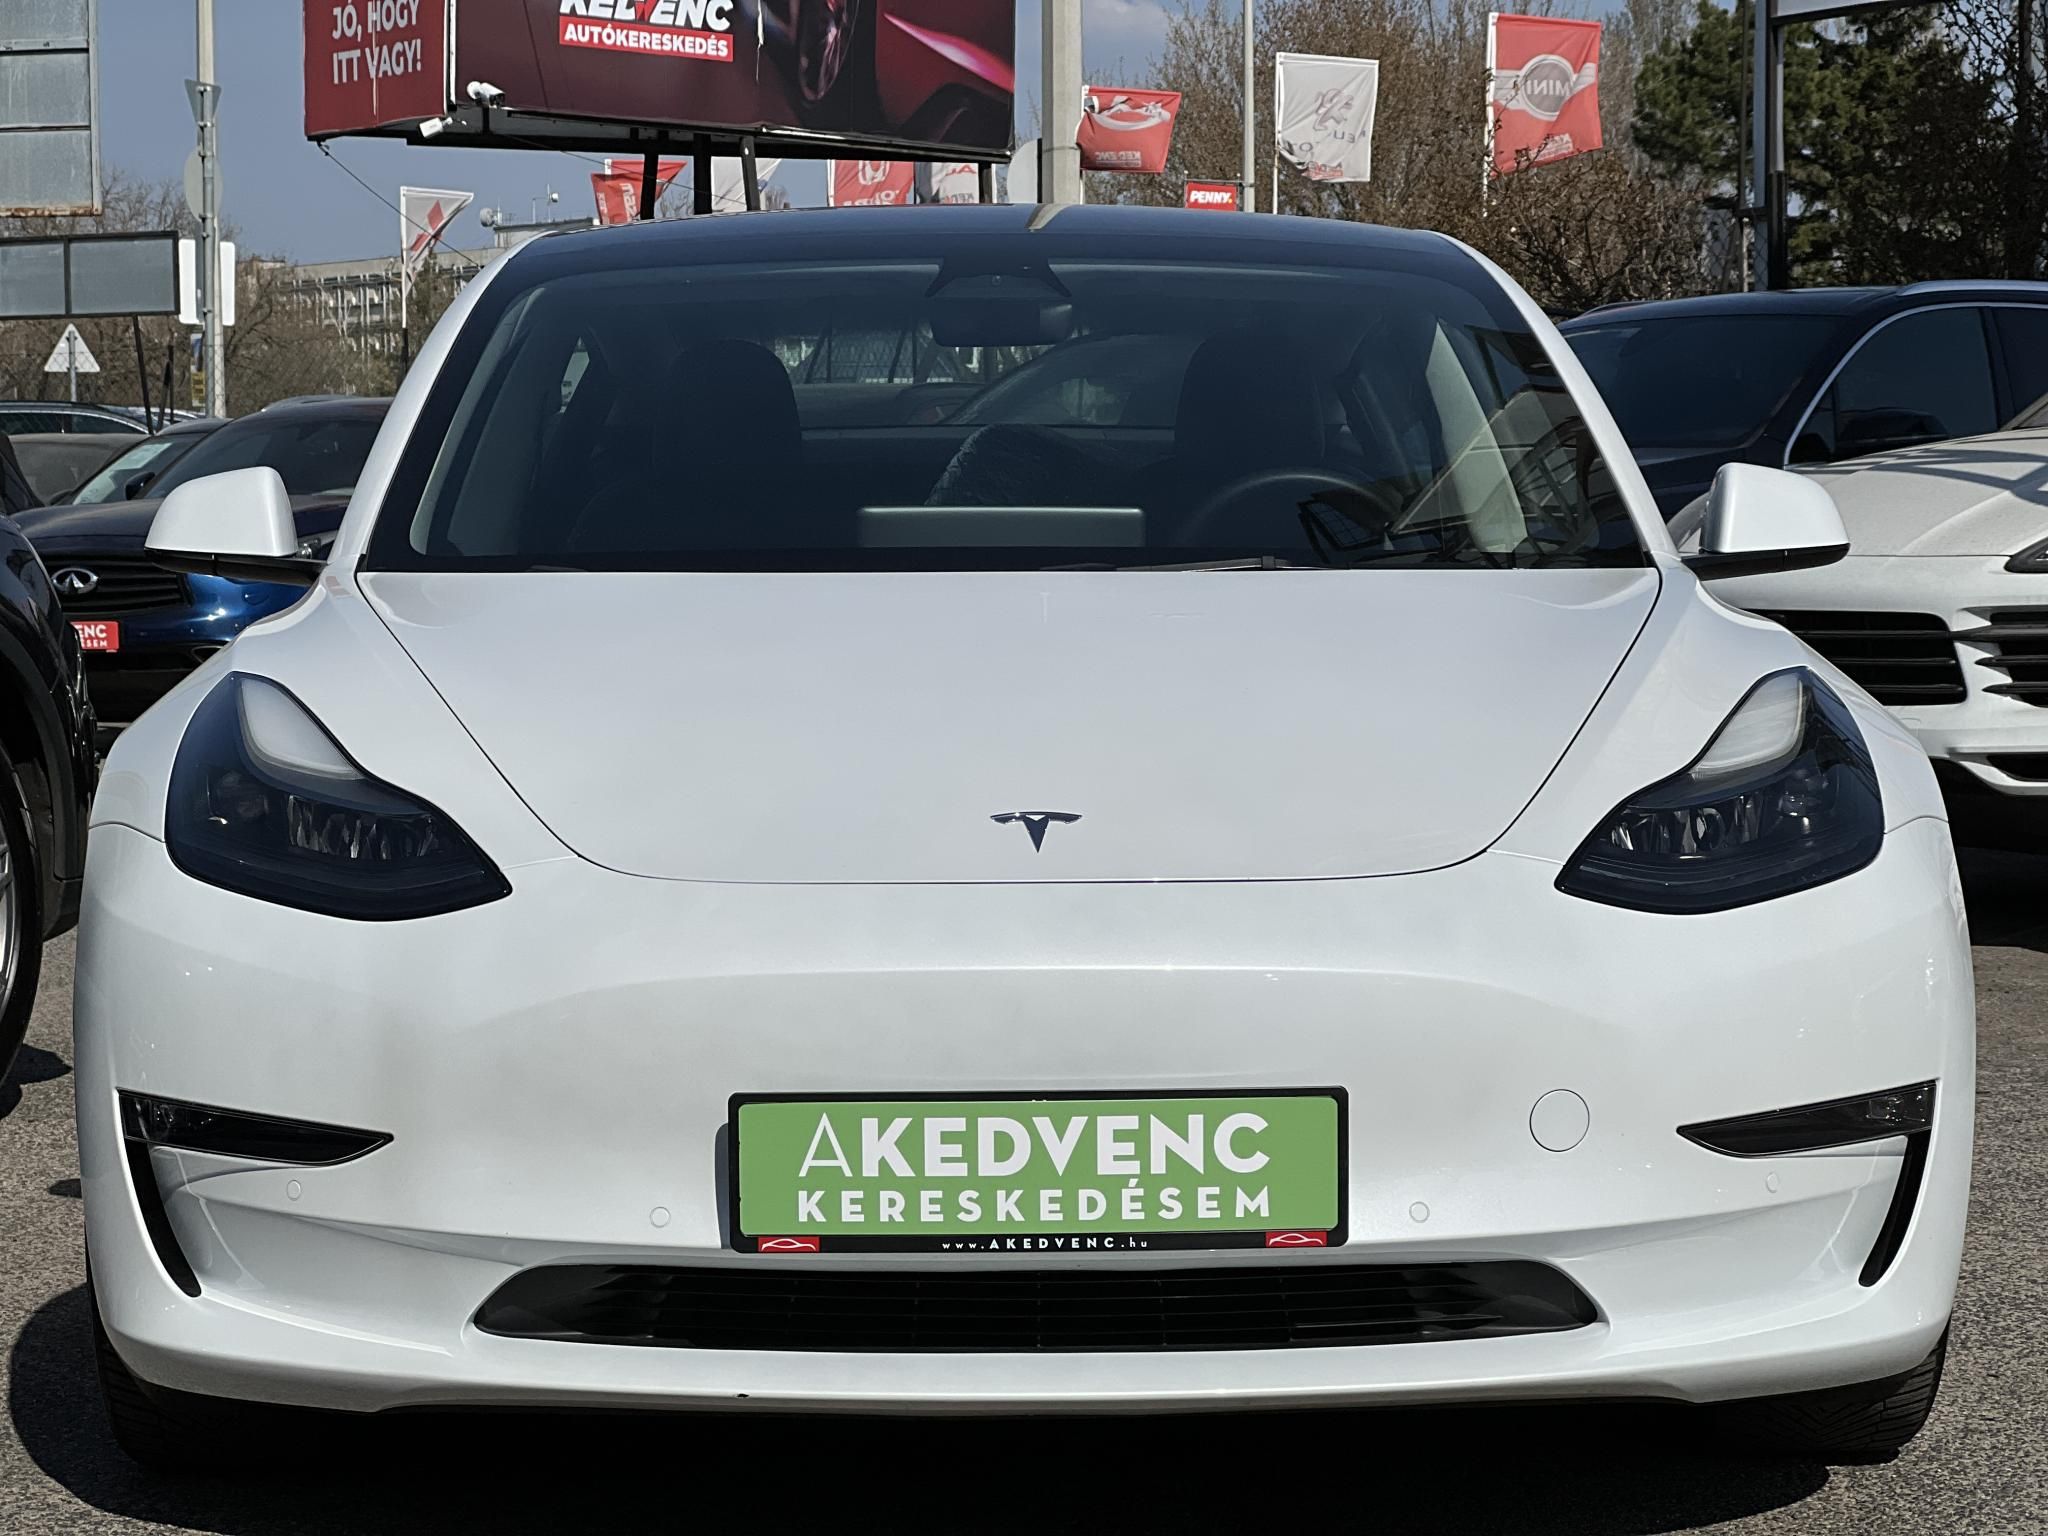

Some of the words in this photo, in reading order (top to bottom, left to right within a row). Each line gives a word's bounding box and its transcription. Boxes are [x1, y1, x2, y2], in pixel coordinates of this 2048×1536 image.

[332, 0, 362, 42] JÓ,
[367, 0, 419, 34] HOGY
[564, 22, 728, 57] AUTÓKERESKEDÉS
[333, 49, 361, 84] ITT
[365, 38, 421, 78] VAGY!
[798, 1177, 1270, 1223] KERESKEDÉSEM
[942, 1237, 1148, 1249] www.AKEDVENC.hu
